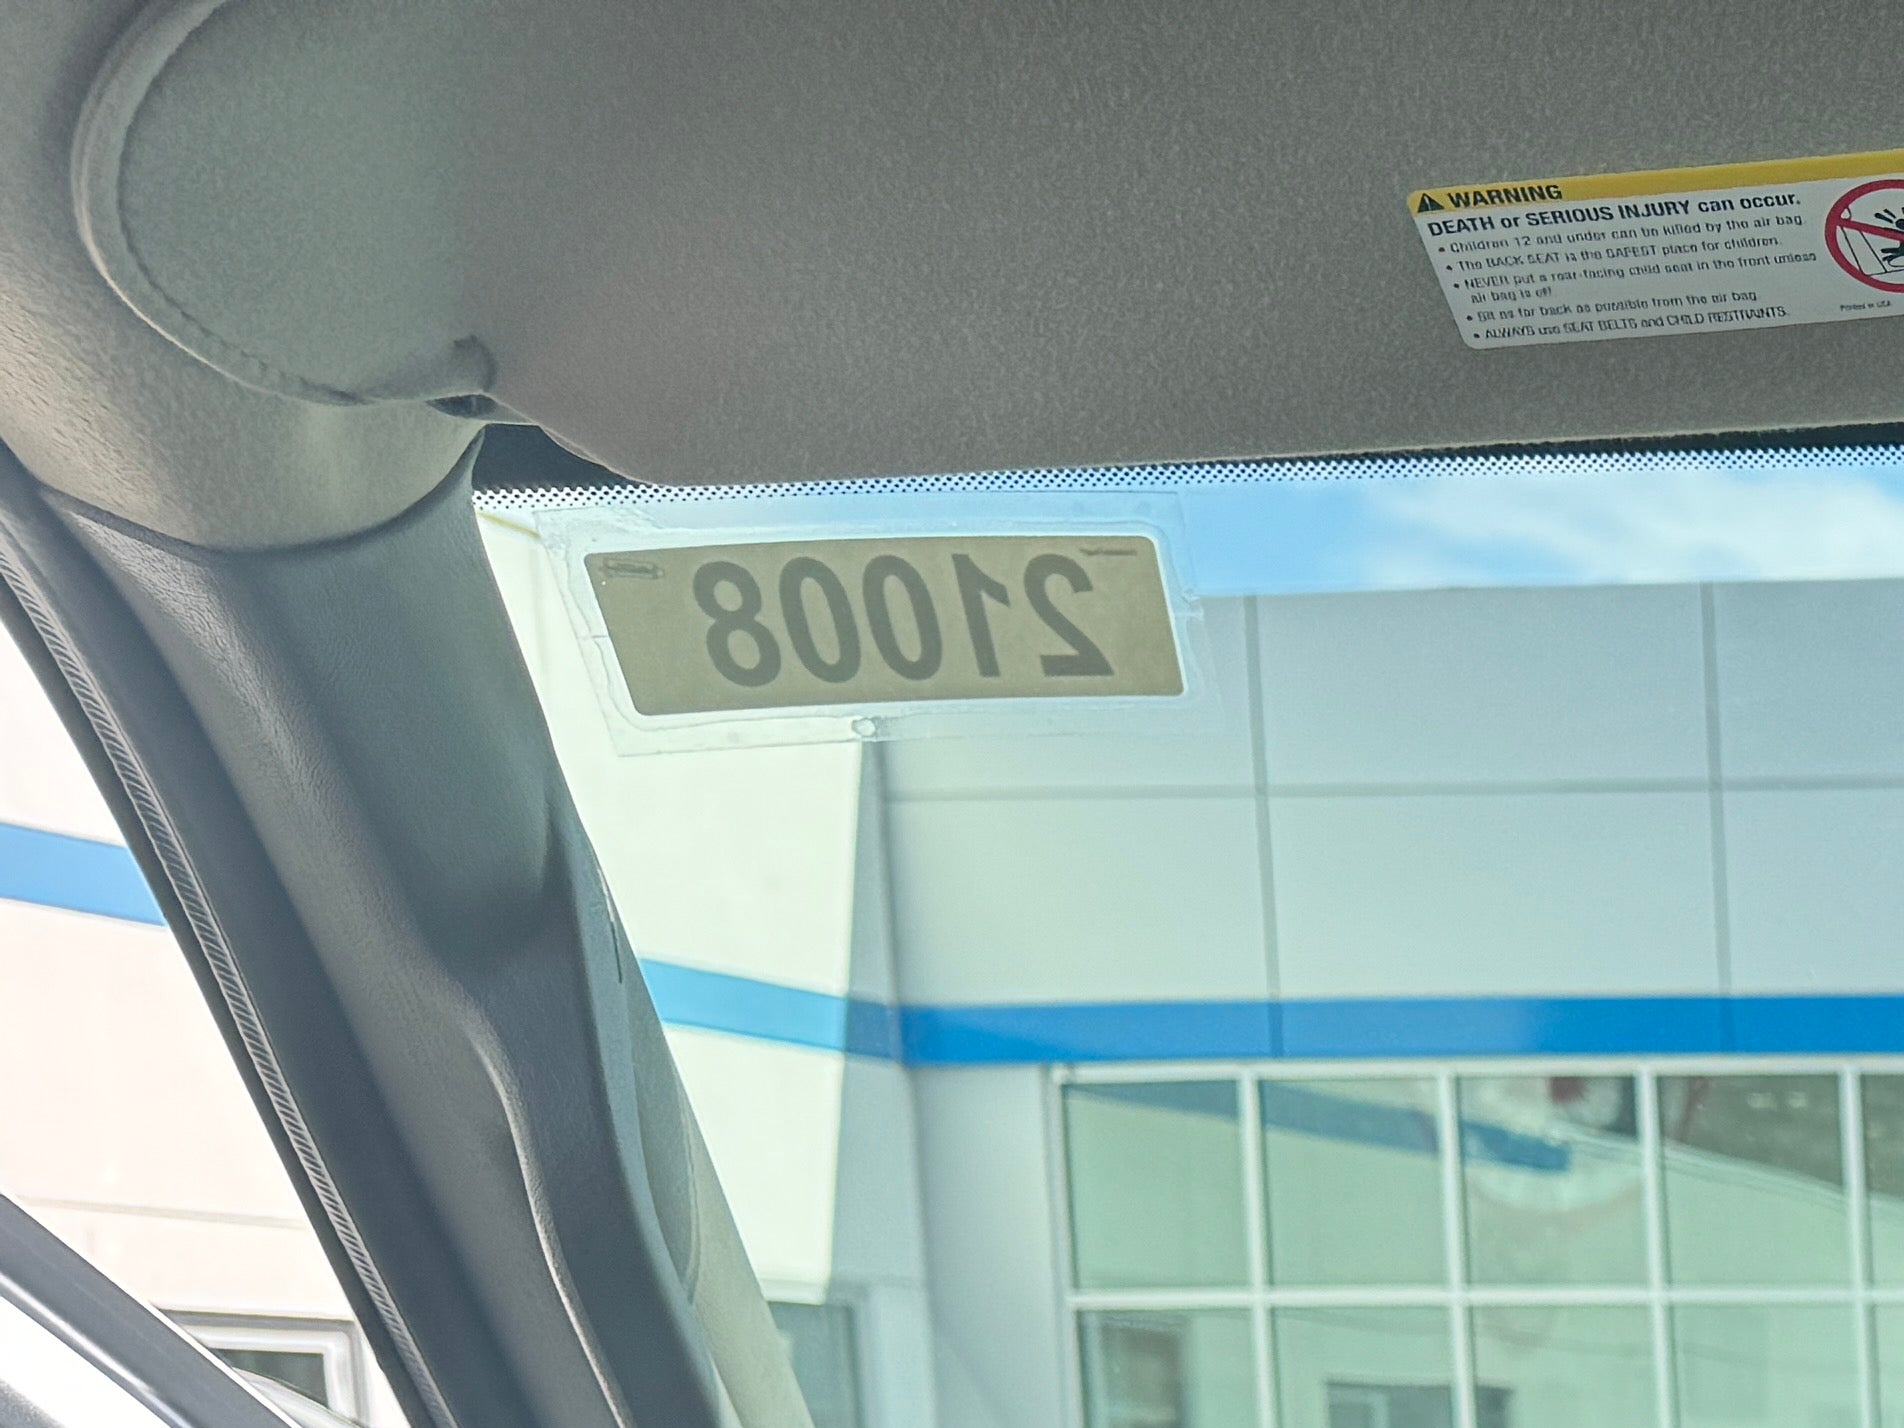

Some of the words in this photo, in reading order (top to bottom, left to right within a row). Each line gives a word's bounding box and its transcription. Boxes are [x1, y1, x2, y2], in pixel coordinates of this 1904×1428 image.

[1447, 184, 1563, 208] WARNING
[1428, 216, 1495, 236] DEATH
[1501, 216, 1520, 228] or
[1525, 206, 1614, 226] SERIOUS
[1618, 200, 1689, 220] INJURY
[1698, 198, 1735, 214] can
[1741, 192, 1801, 210] occur.
[1516, 236, 1531, 247] 12
